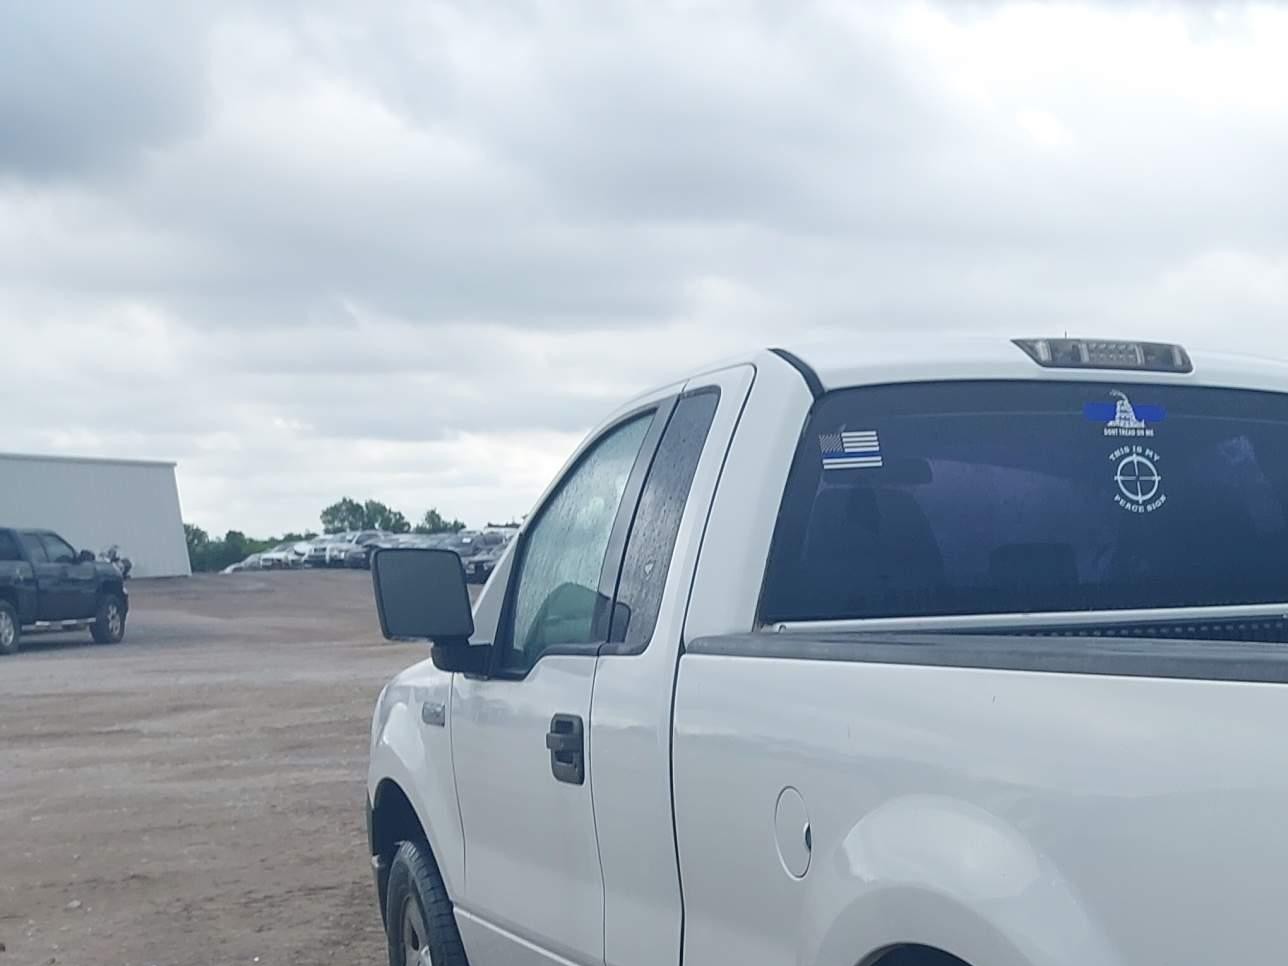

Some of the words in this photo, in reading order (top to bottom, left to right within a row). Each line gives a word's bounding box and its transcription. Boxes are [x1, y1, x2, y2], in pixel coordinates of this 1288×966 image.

[1109, 445, 1130, 461] THIS
[1132, 445, 1142, 453] IS
[1145, 448, 1160, 462] MY
[1114, 494, 1144, 513] PEACE
[1146, 494, 1167, 512] SIGN
